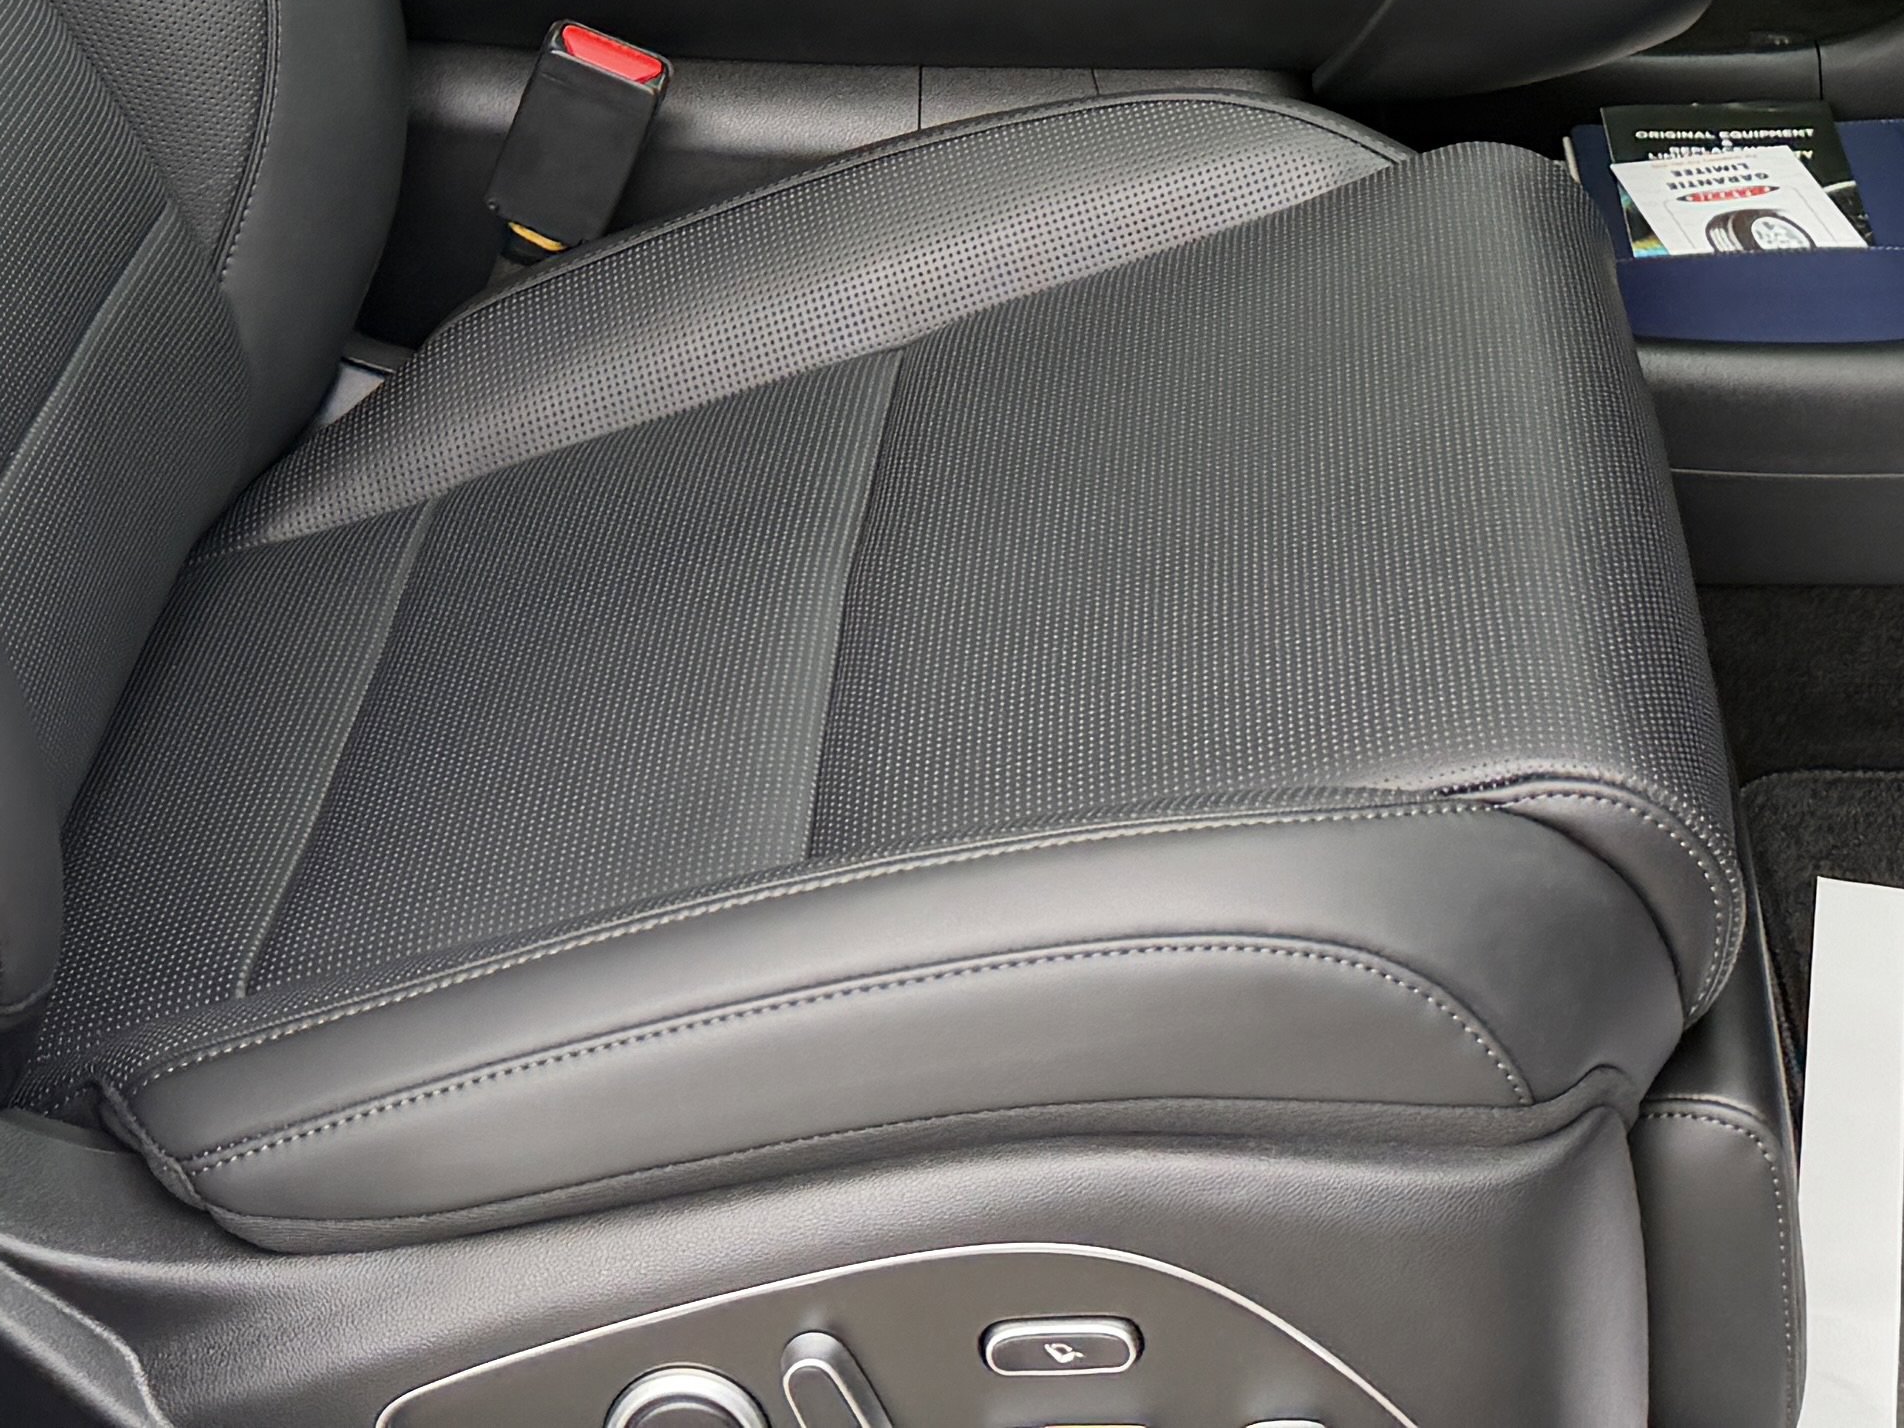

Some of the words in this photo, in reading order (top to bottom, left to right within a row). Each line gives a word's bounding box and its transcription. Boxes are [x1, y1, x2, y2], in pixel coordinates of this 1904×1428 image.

[1635, 130, 1716, 140] ORIGINAL
[1718, 128, 1815, 140] EQUIPMENT
[1666, 172, 1769, 190] GARANTIE
